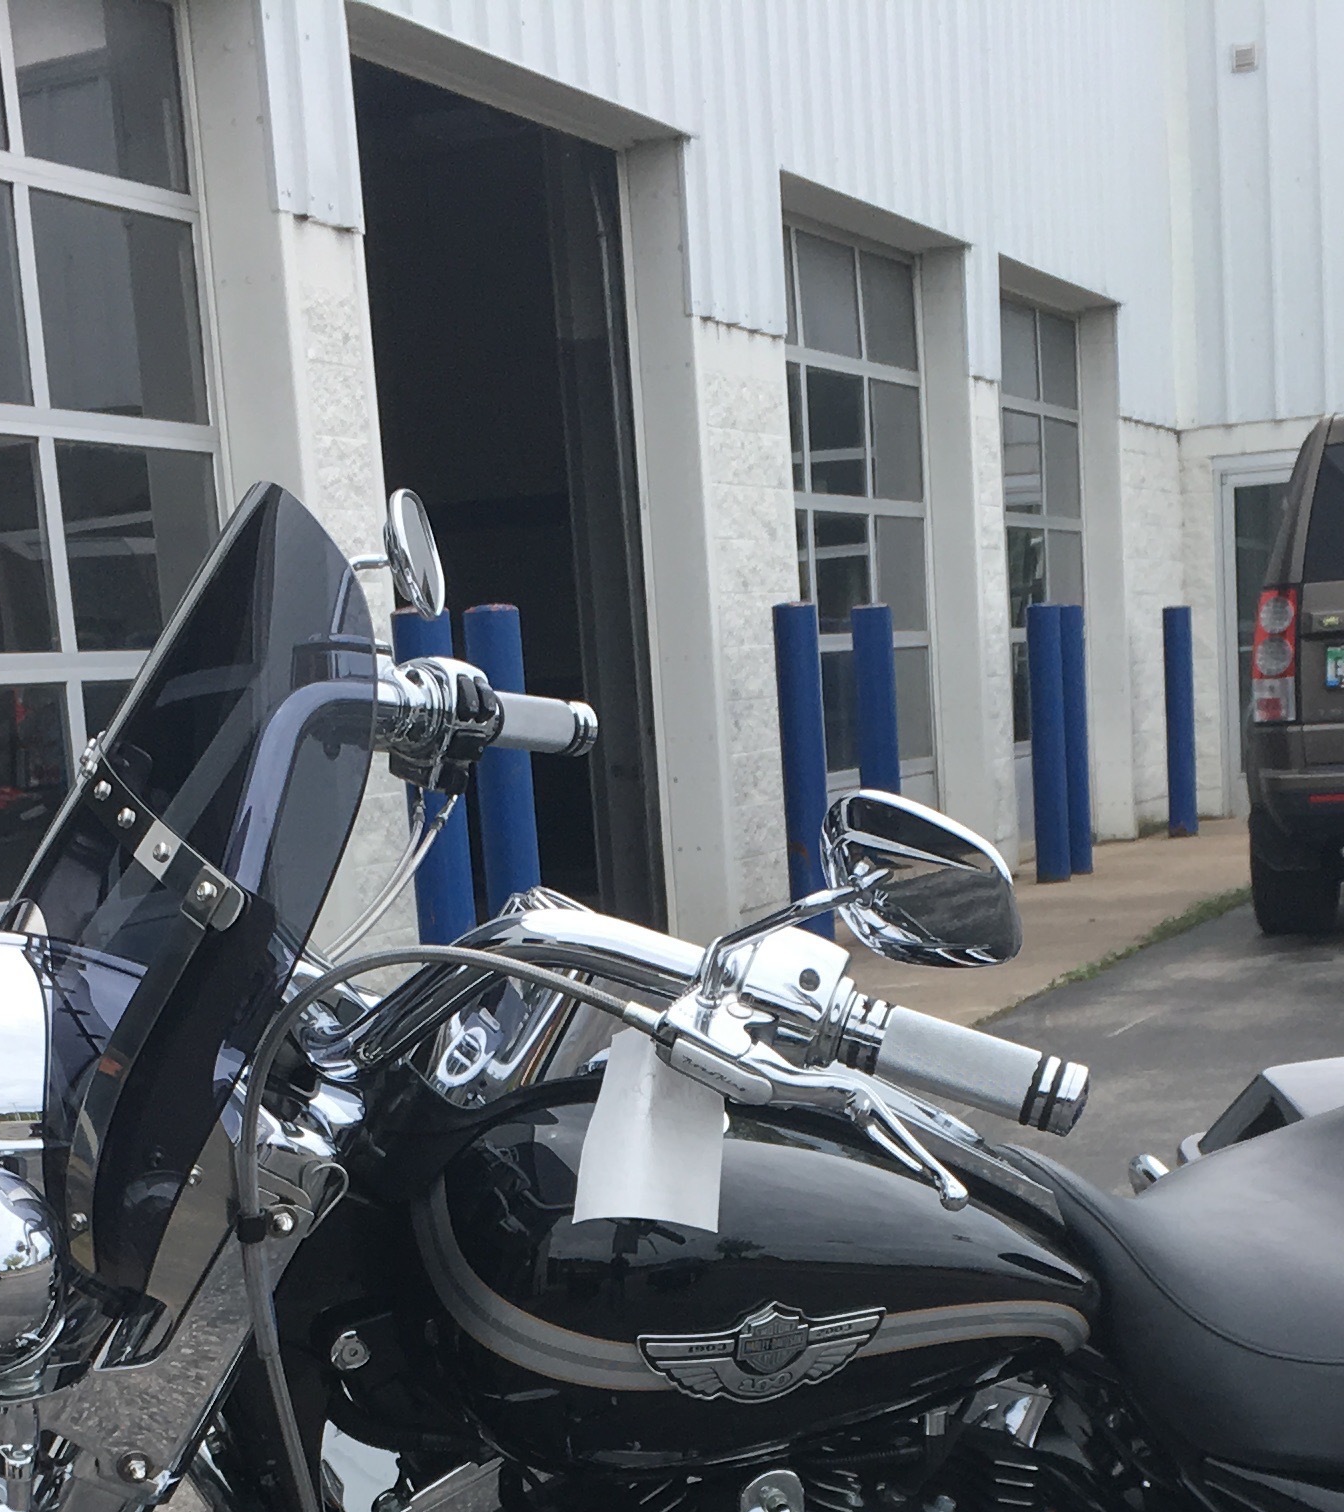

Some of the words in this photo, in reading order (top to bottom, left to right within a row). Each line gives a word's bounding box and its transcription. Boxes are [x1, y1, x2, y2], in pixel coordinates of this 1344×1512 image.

[815, 1322, 854, 1338] 2003
[687, 1342, 728, 1354] 1903
[738, 1371, 794, 1391] 100
